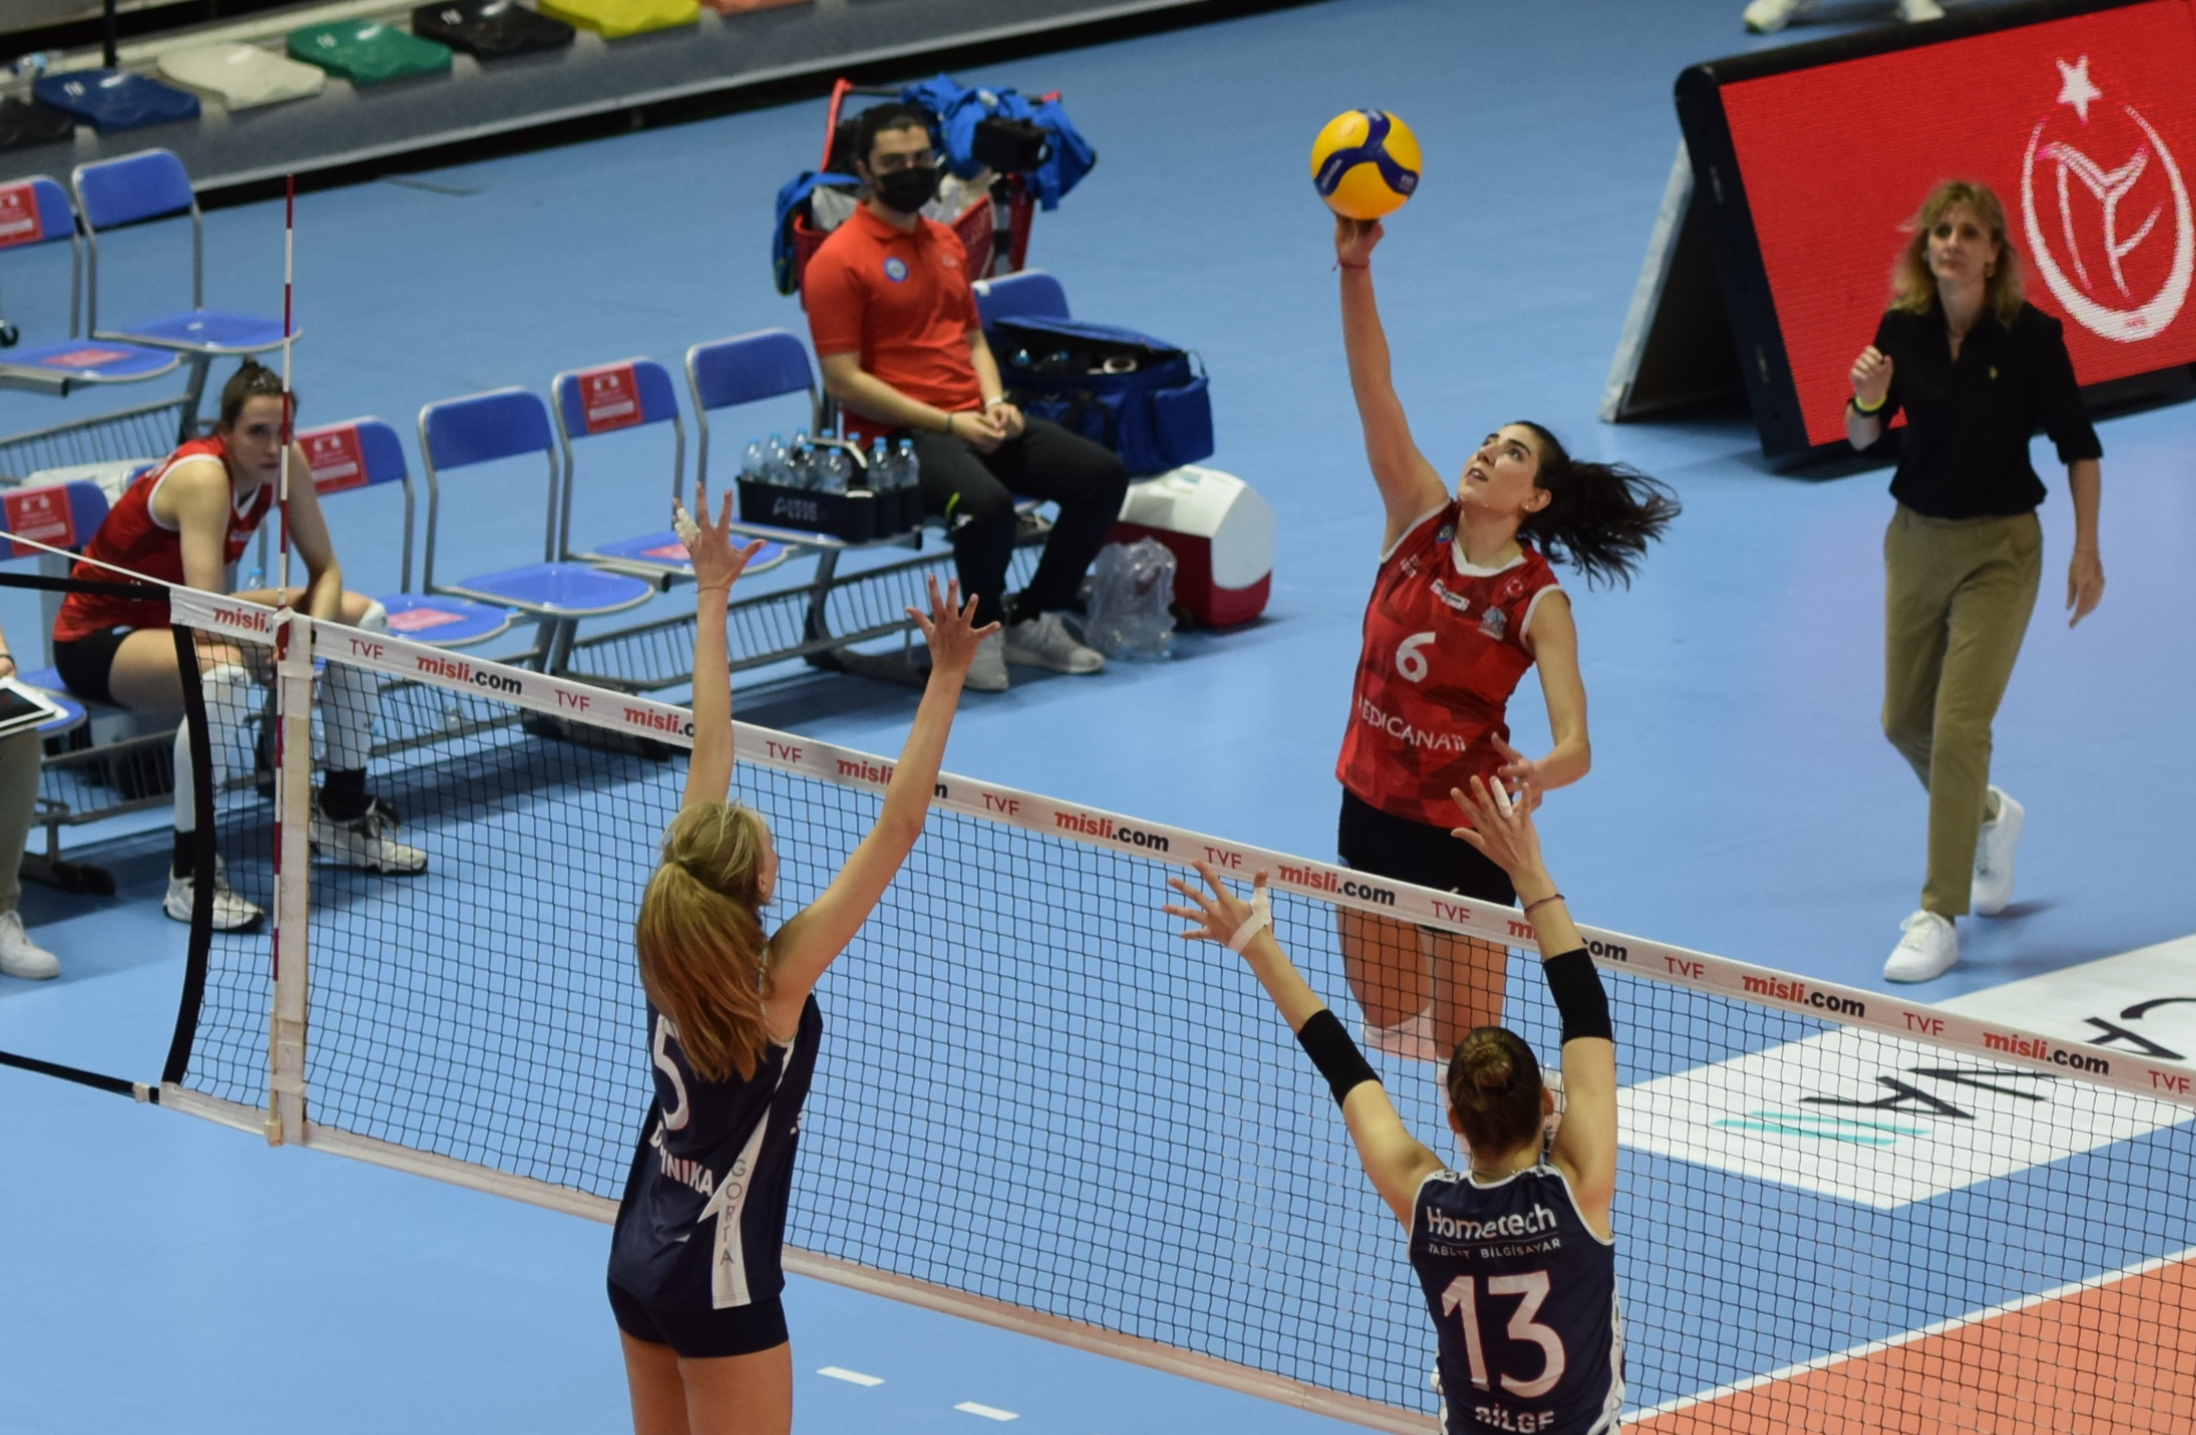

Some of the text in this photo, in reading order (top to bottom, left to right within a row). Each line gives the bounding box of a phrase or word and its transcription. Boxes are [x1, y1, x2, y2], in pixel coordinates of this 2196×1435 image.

[349, 638, 384, 660] TVF
[1395, 631, 1436, 683] 6
[416, 655, 523, 695] misli.com
[554, 688, 590, 712] TVF
[766, 741, 803, 764] TVF
[981, 793, 1020, 817] TVF
[1054, 811, 1169, 852] misli.com
[1203, 846, 1242, 870] TVF
[1278, 864, 1396, 907] misli.com
[1431, 900, 1471, 924] TVF
[1664, 955, 1705, 980] TVF
[1742, 974, 1865, 1018] misli.com
[1903, 1011, 1944, 1037] TVF
[1983, 1030, 2109, 1076] misli.com
[2147, 1069, 2191, 1095] TVF
[1426, 1203, 1558, 1240] Hometech
[1441, 1270, 1566, 1398] 13
